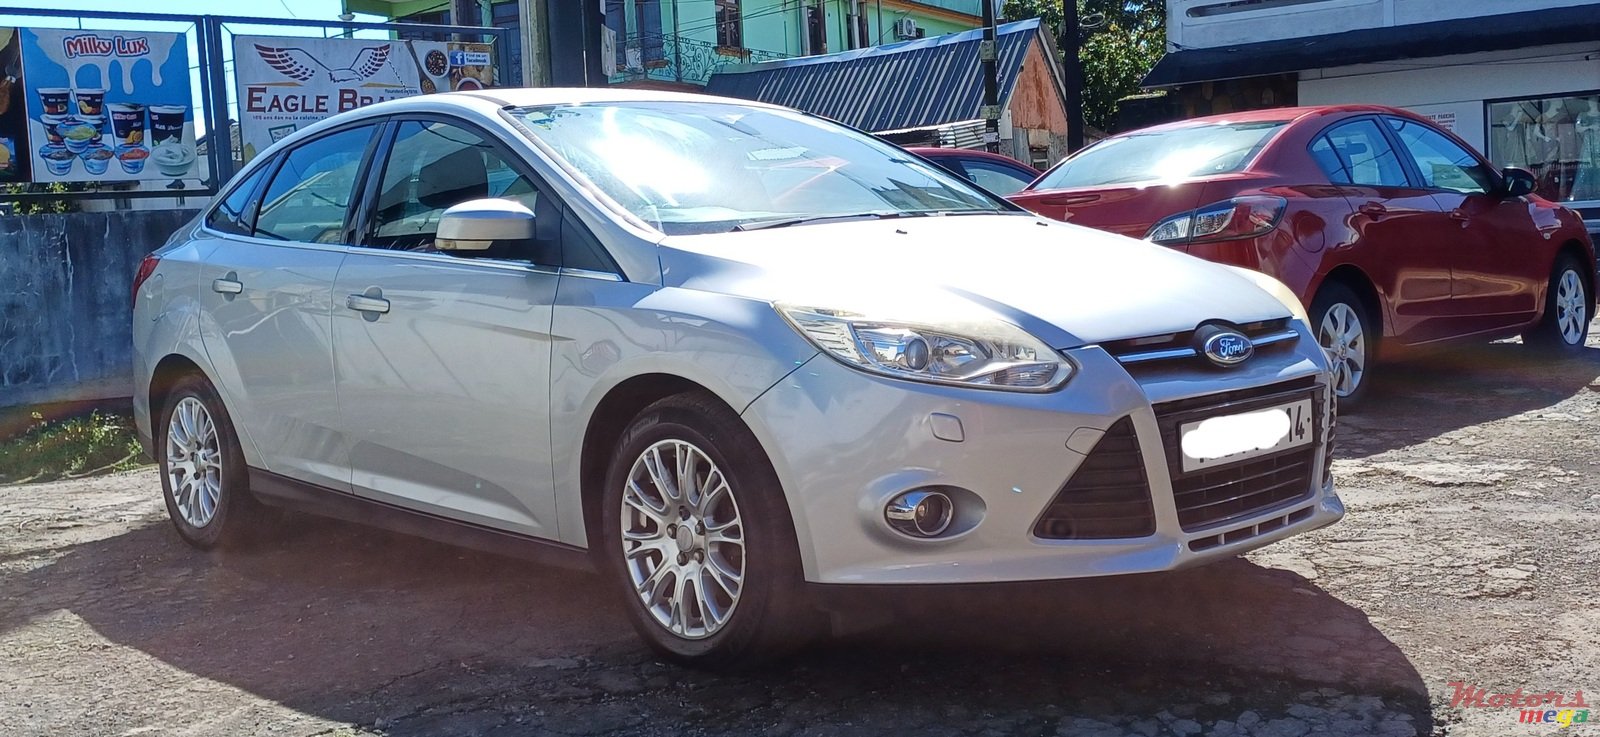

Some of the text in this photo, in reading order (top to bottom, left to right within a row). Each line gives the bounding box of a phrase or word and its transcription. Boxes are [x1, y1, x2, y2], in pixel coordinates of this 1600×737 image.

[64, 35, 150, 58] Milky Lux
[247, 87, 329, 113] EAGLE
[1219, 337, 1246, 356] Ford
